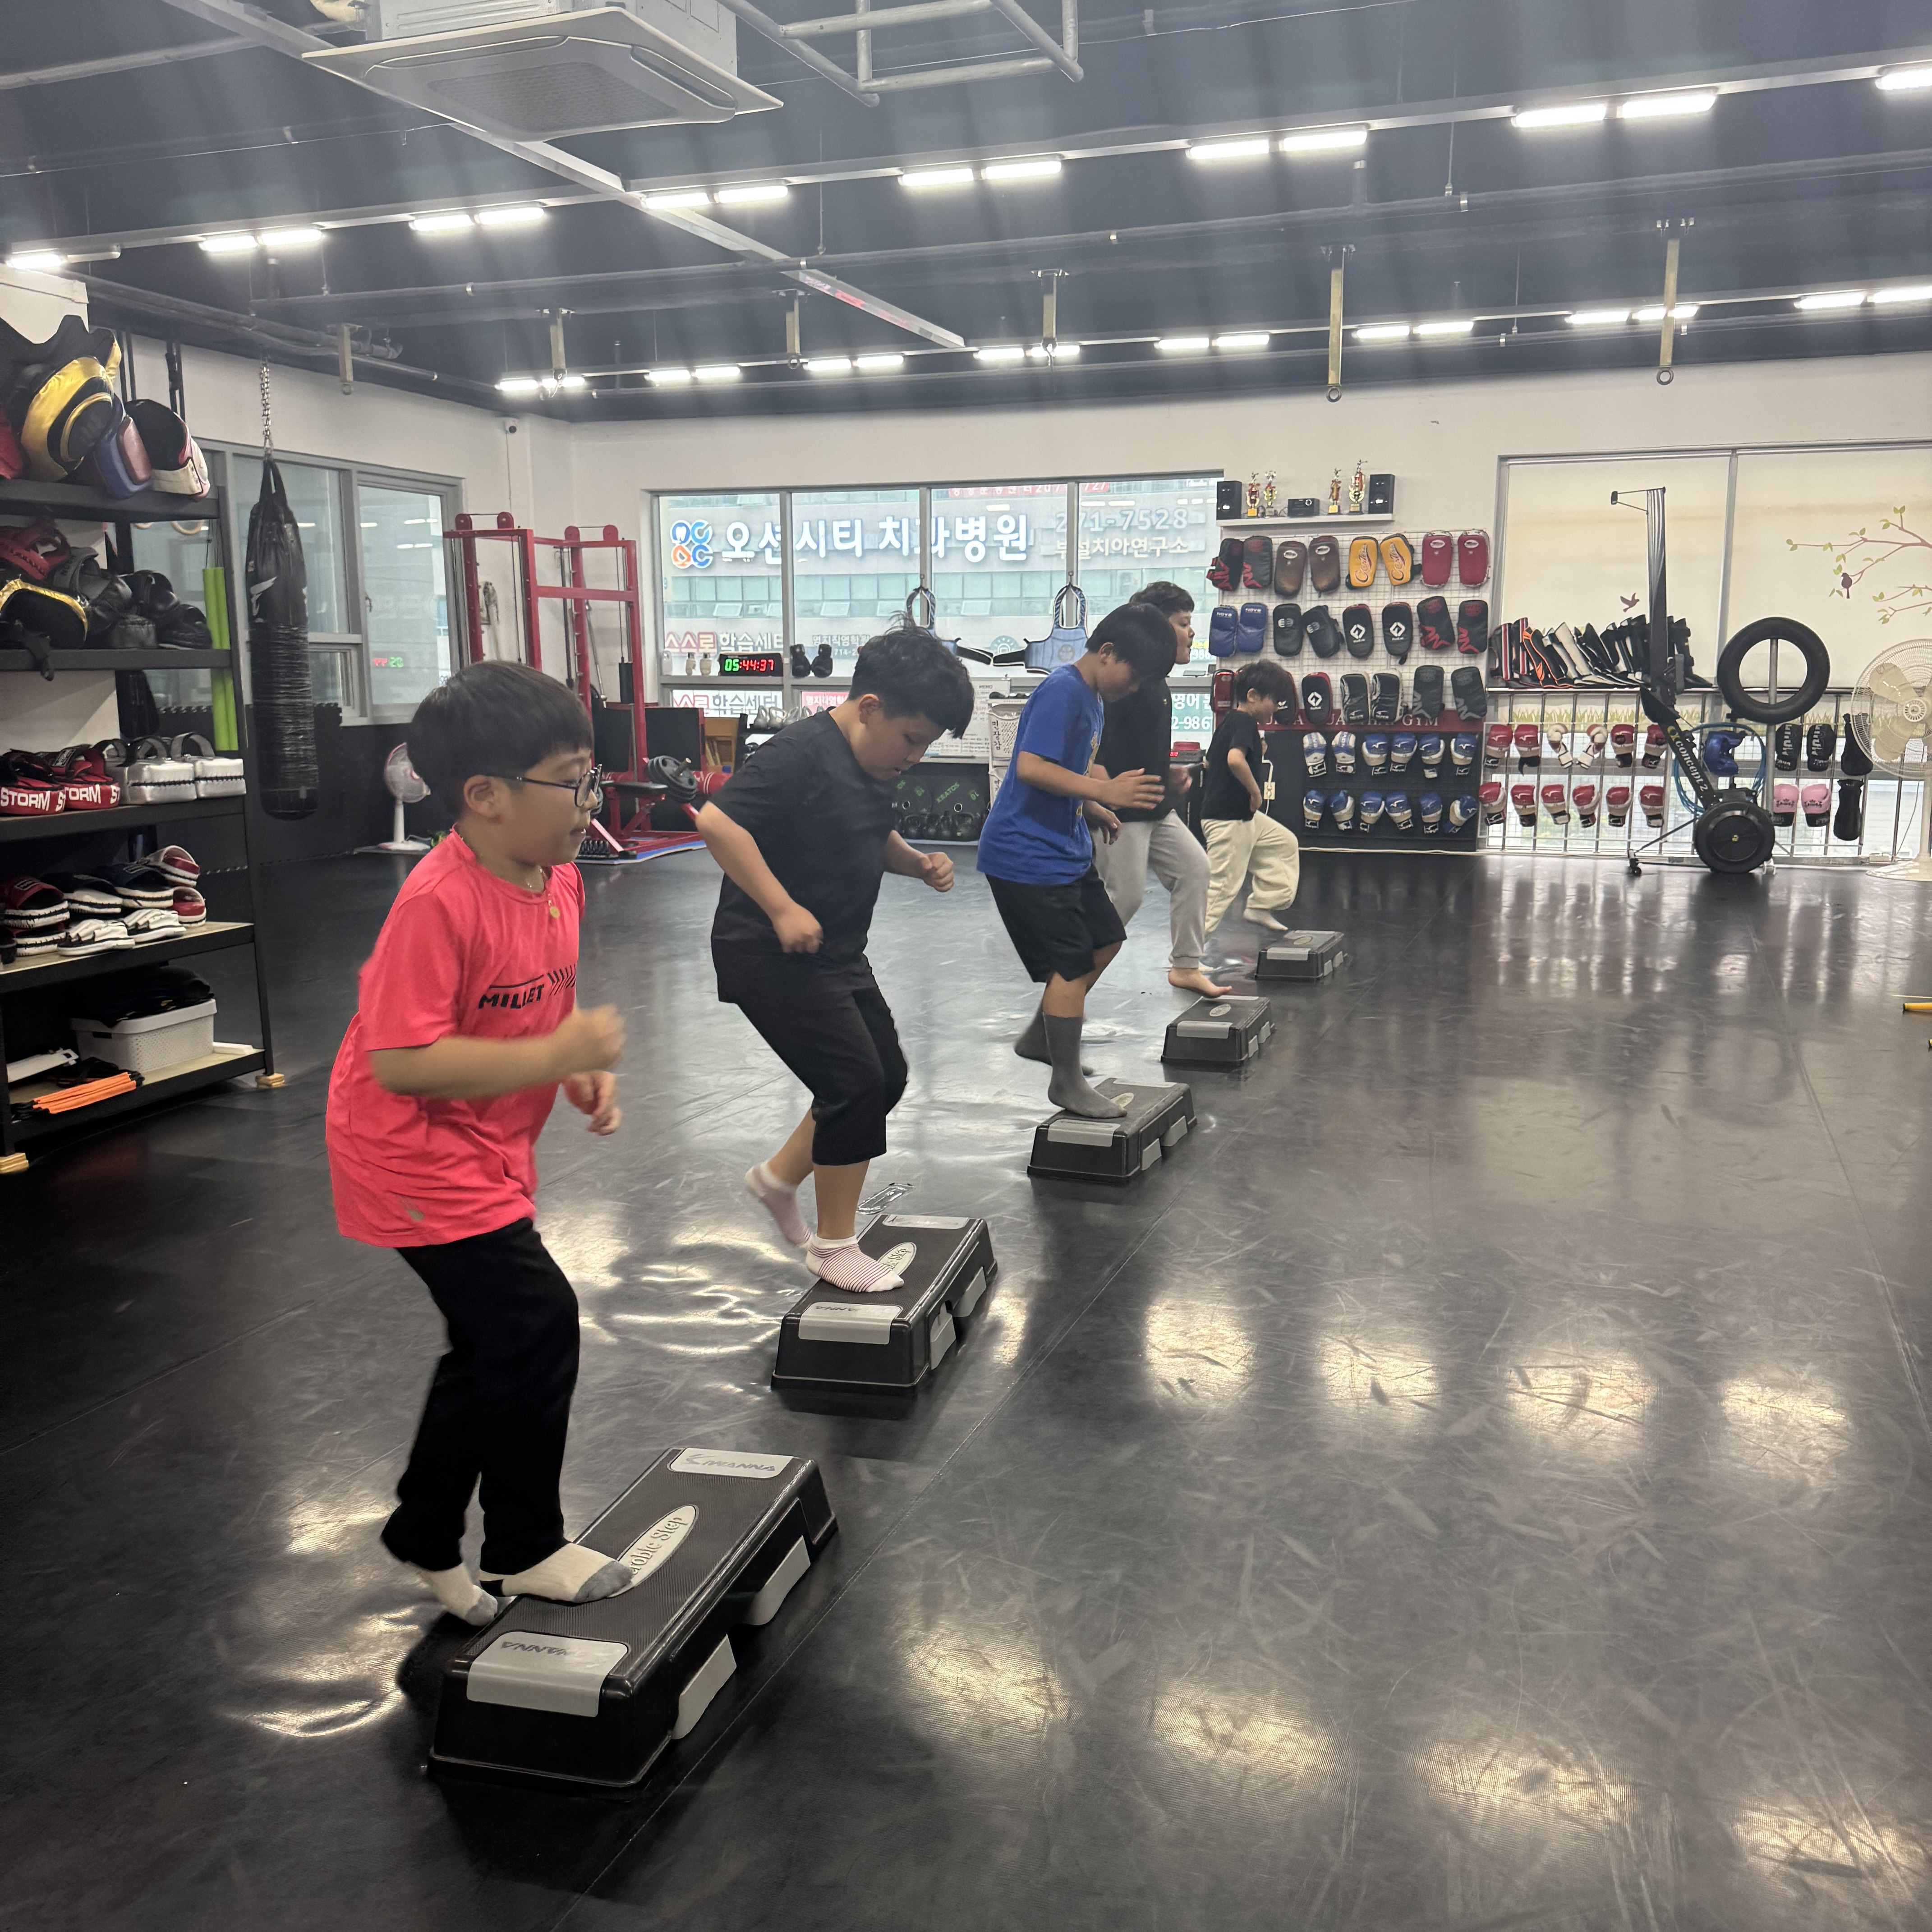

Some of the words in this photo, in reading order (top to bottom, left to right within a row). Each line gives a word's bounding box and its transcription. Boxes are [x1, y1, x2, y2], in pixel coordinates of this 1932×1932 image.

[722, 518, 863, 565] 오션시티
[879, 514, 1026, 562] 치과병원
[725, 659, 774, 671] 05:44:37
[0, 787, 51, 811] STORM
[64, 784, 101, 804] TORM
[630, 1542, 662, 1575] erobic
[651, 1517, 689, 1541] Step
